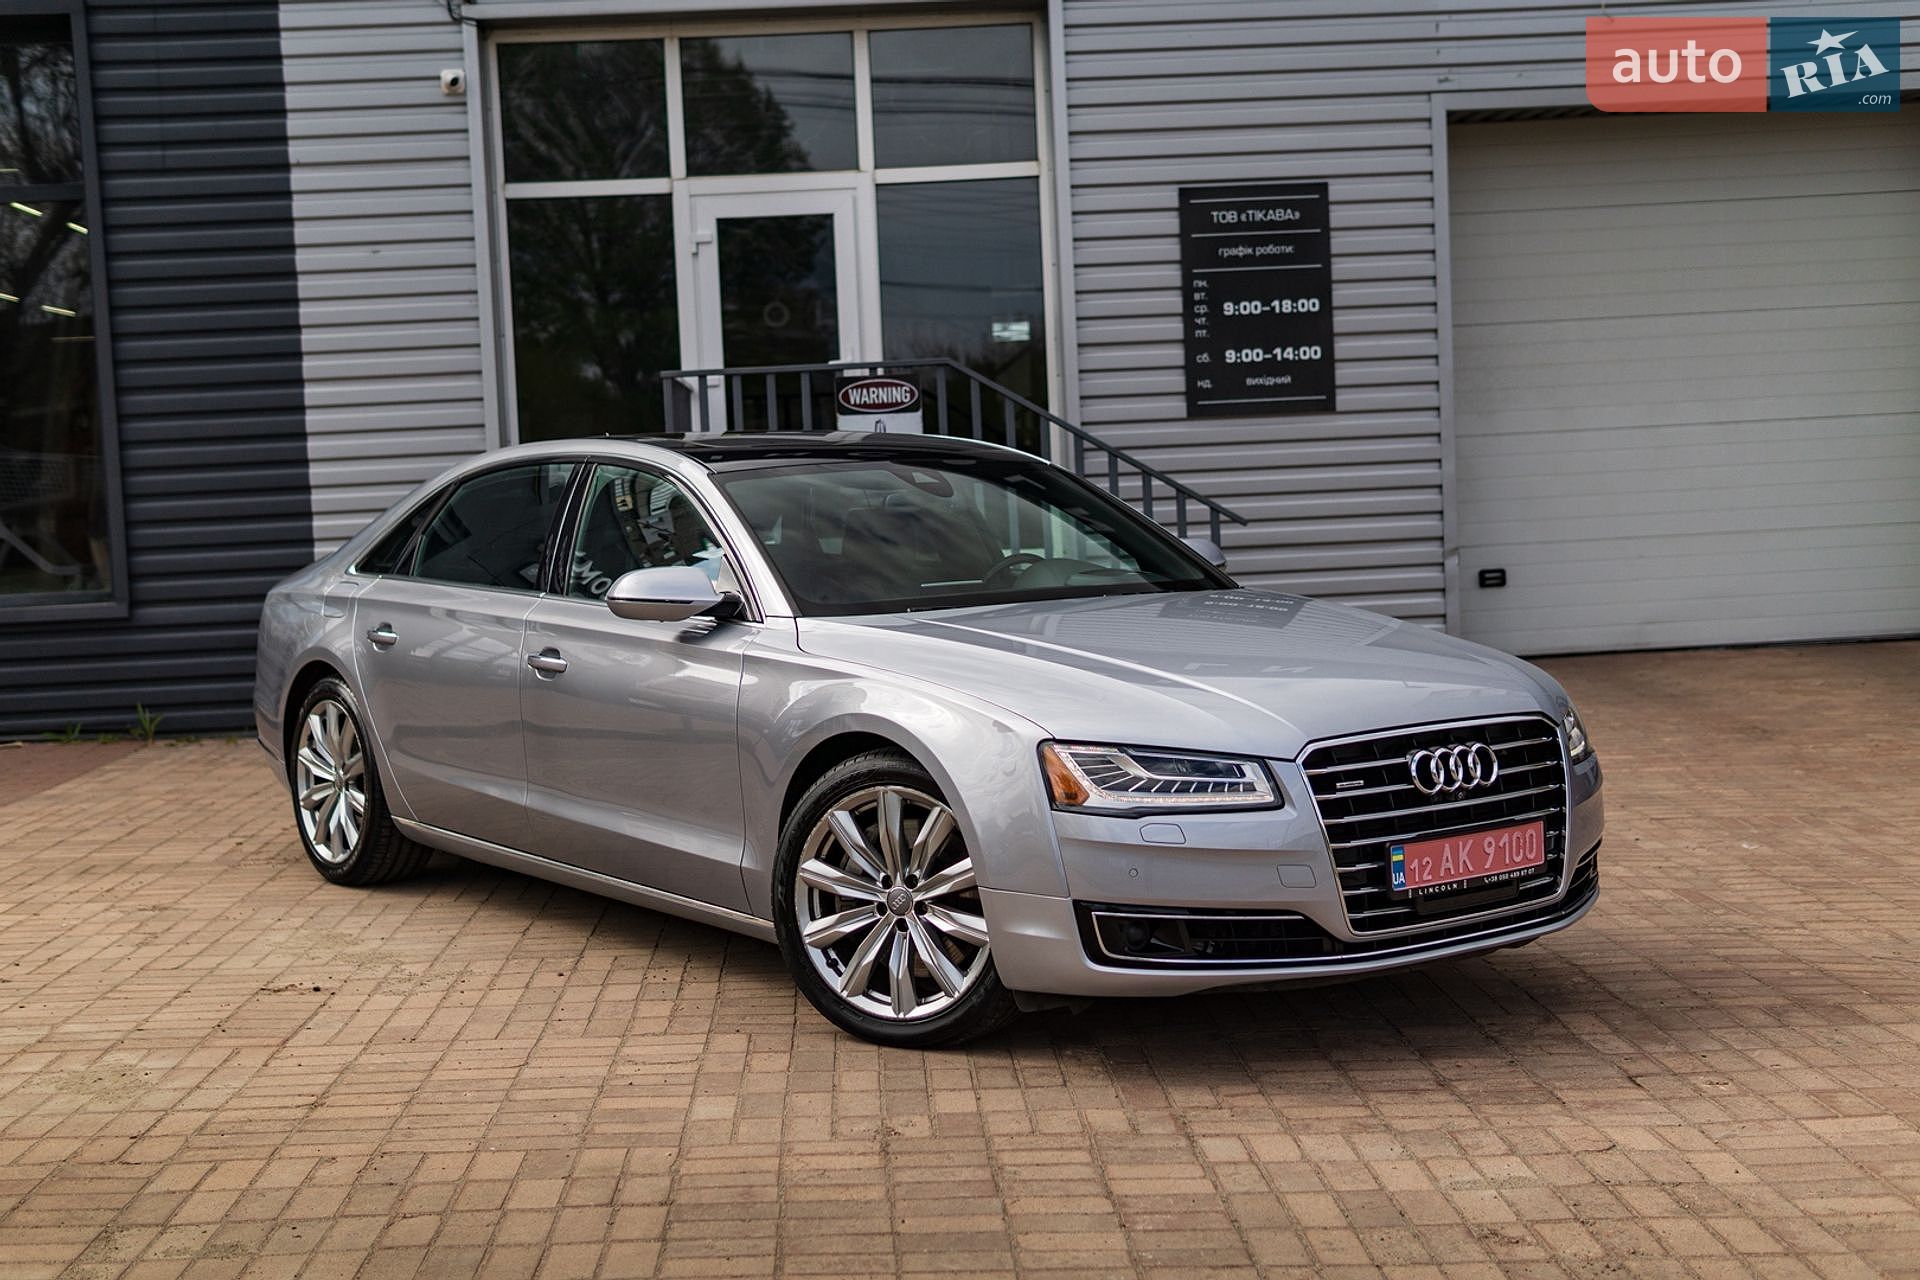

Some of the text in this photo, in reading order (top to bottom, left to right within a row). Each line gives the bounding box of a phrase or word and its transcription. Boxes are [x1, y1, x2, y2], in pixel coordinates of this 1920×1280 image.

[1210, 210, 1238, 223] ТОВ
[1218, 245, 1254, 258] графік
[1246, 374, 1292, 386] вихідний
[847, 386, 911, 405] WARNING
[1392, 829, 1537, 885] UA 12 AK 9100
[1418, 883, 1458, 895] LINCOLN
